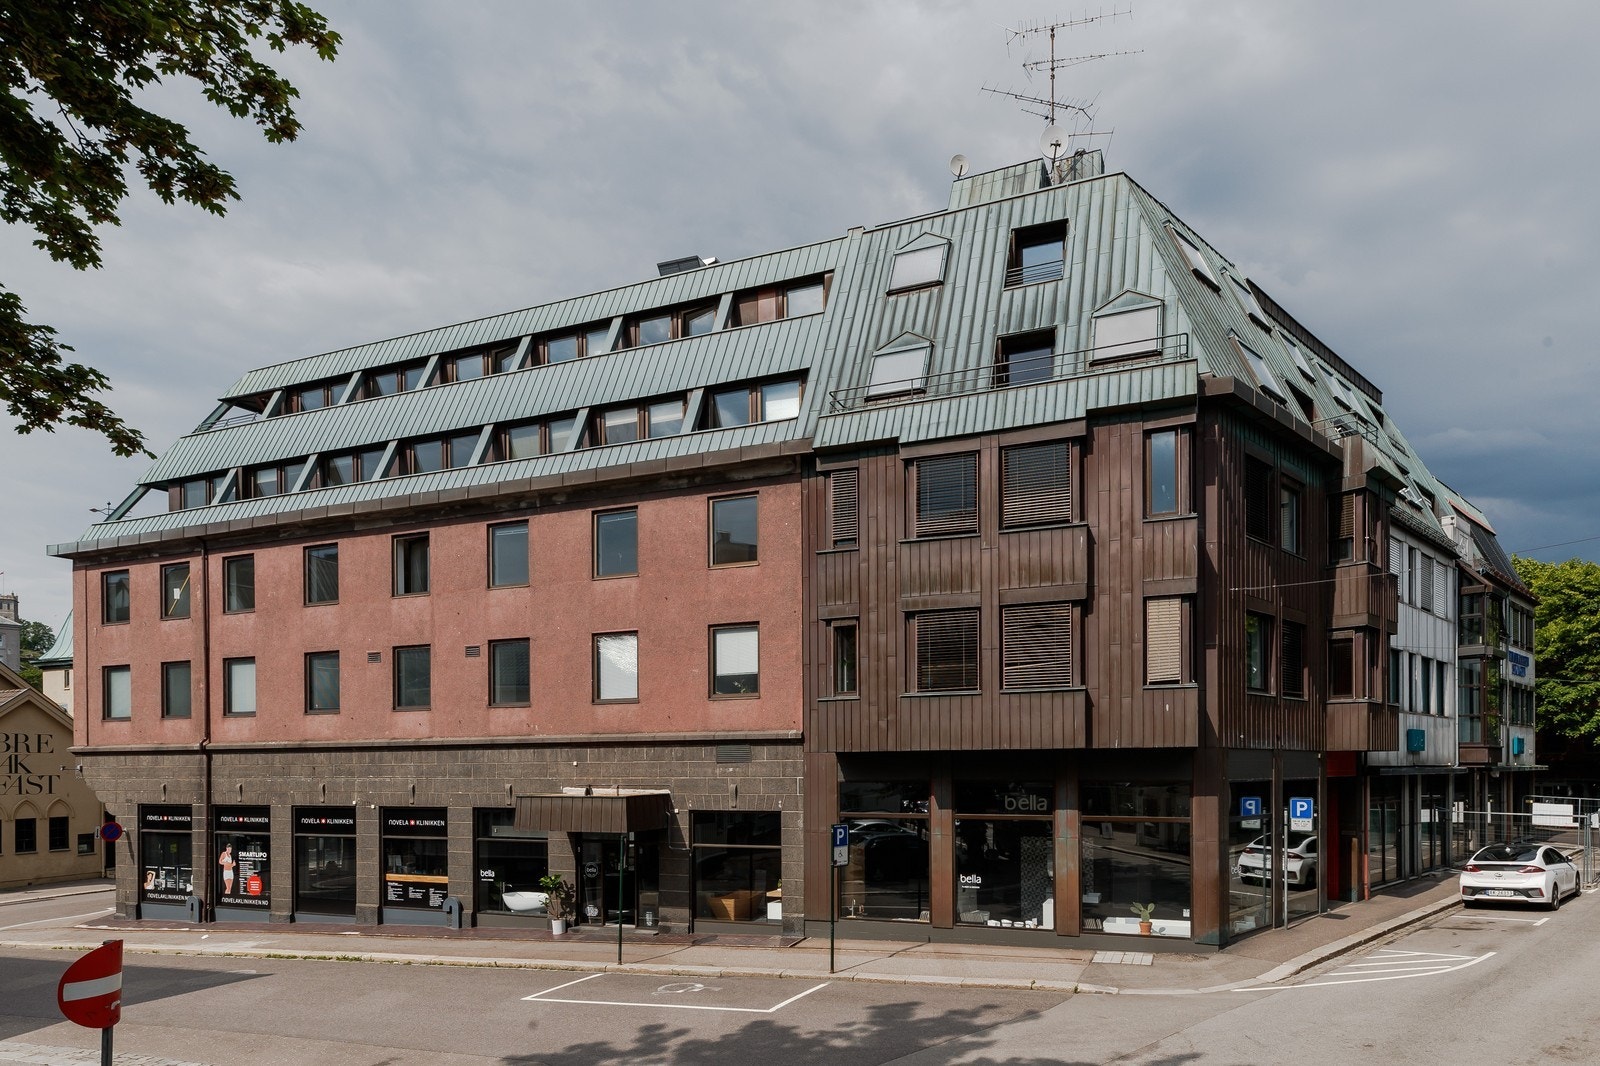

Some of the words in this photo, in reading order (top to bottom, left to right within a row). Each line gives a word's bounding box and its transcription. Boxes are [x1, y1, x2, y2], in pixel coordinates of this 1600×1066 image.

[1004, 794, 1048, 811] bella
[1296, 801, 1308, 817] P
[836, 828, 845, 845] P
[480, 869, 495, 878] bella
[960, 873, 982, 884] bella
